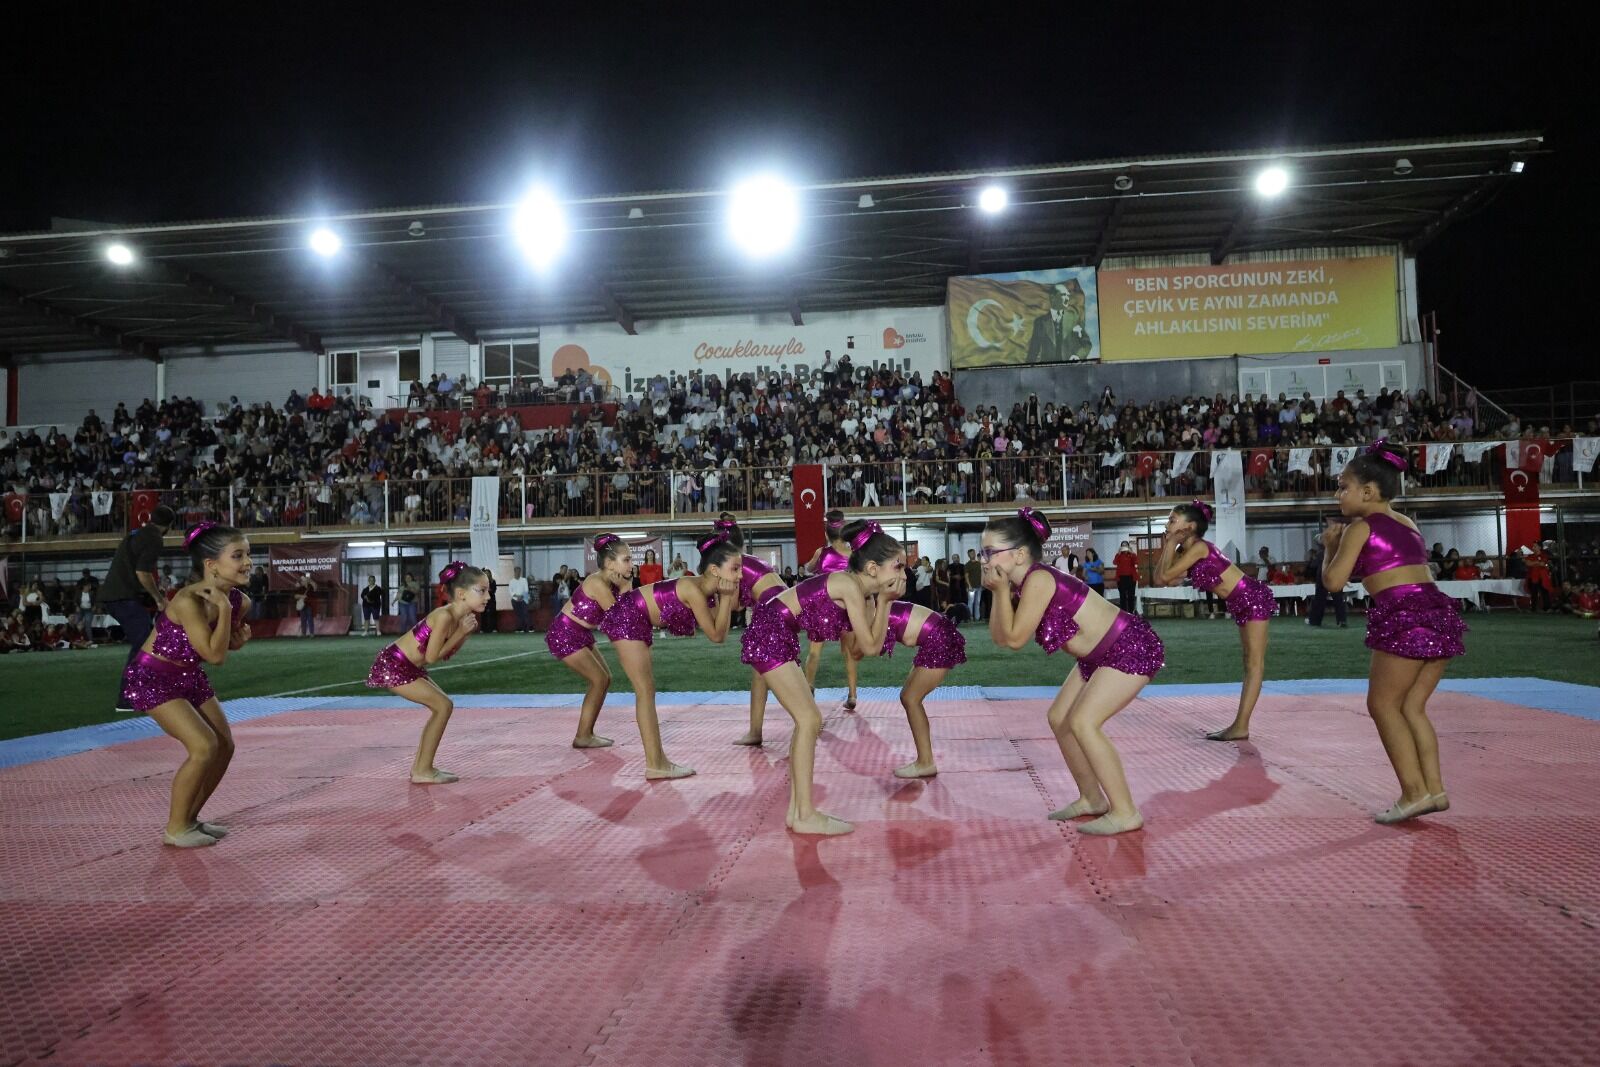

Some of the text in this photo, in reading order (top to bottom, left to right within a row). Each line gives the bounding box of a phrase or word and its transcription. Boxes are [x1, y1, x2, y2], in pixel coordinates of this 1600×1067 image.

[1127, 277, 1168, 292] "BEN
[1173, 271, 1282, 290] SPORCUNUN
[1123, 290, 1339, 318] ÇEVİK VE AYNI ZAMANDA
[1134, 311, 1330, 336] AHLAKLISINI SEVERİM"
